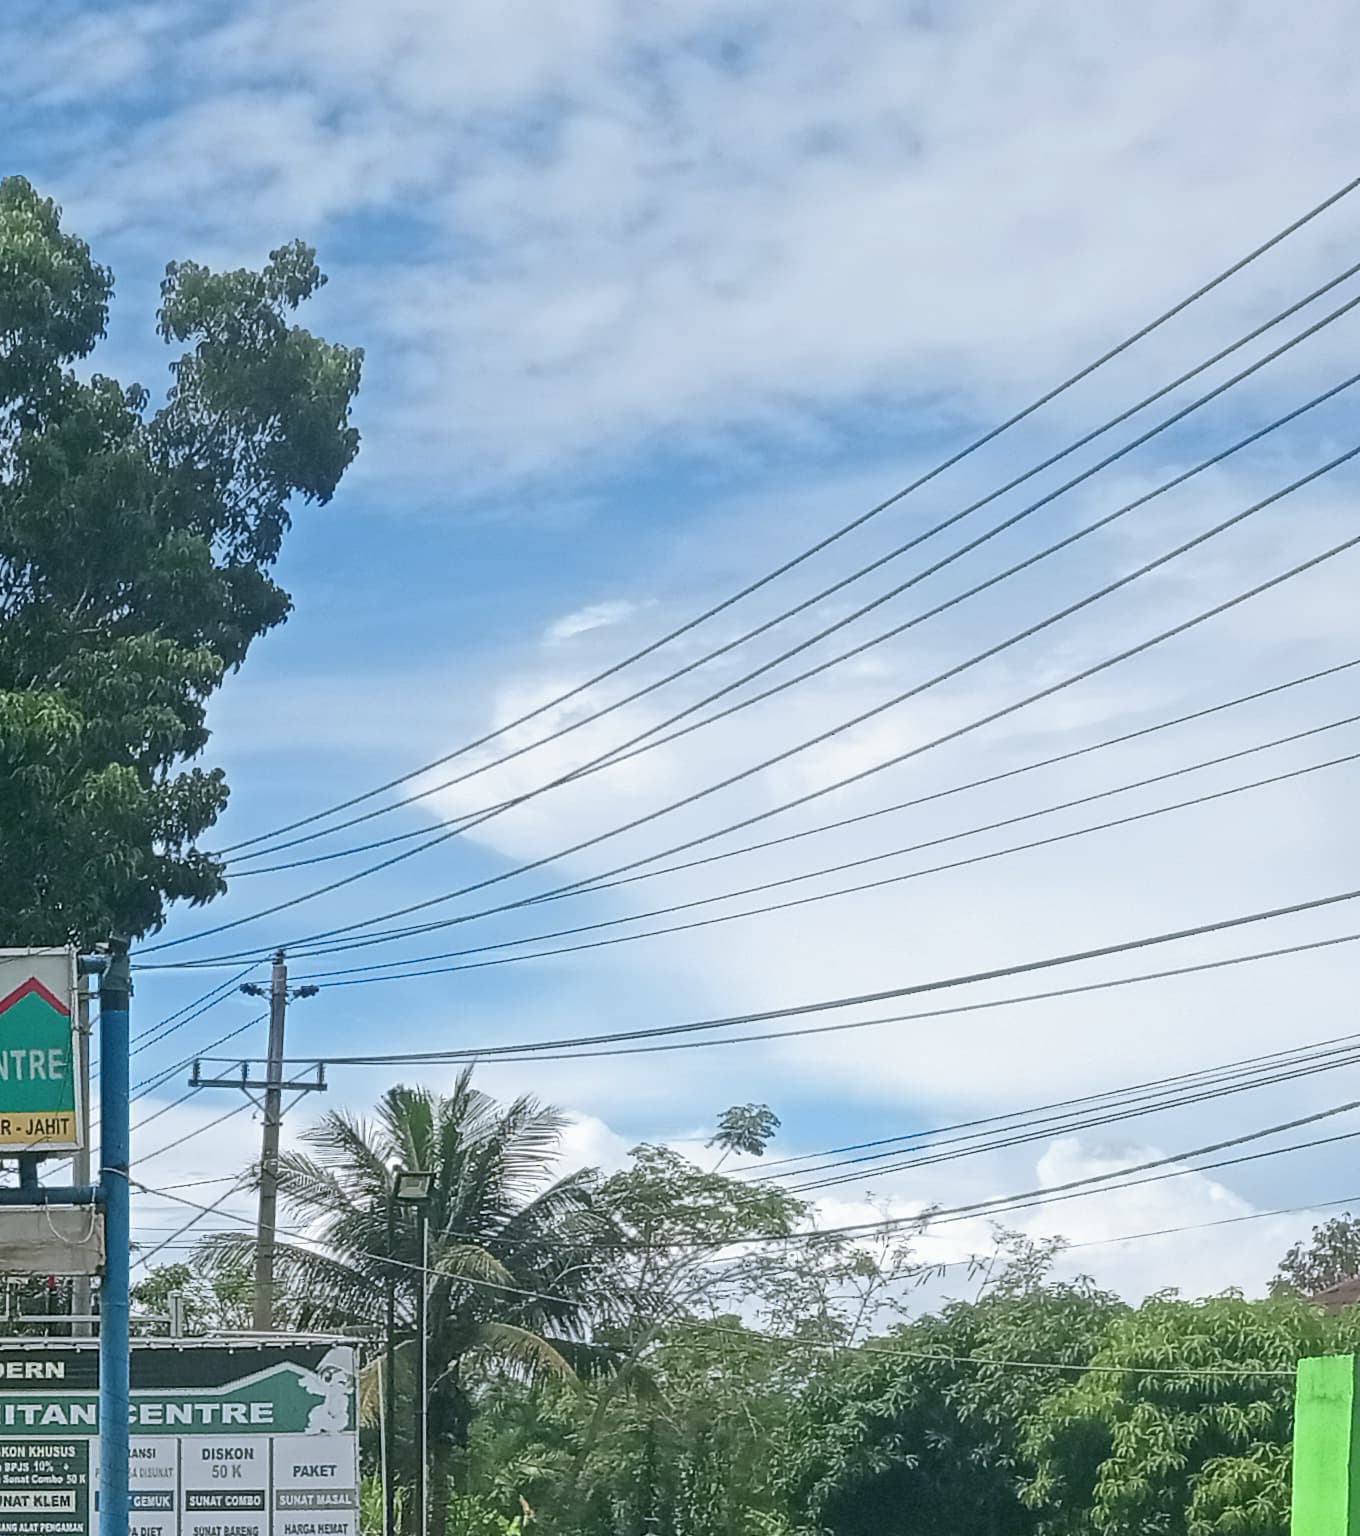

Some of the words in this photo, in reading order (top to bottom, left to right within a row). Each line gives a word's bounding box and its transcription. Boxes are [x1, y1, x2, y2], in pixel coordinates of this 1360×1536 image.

[26, 1118, 70, 1136] JAHIT
[29, 1446, 76, 1457] KHUSUS
[202, 1448, 254, 1460] DISKON
[4, 1462, 29, 1472] BPJS
[33, 1461, 54, 1472] 10%
[212, 1465, 228, 1478] 50
[232, 1465, 243, 1478] K
[293, 1464, 337, 1477] PAKET
[66, 1474, 77, 1484] 50
[33, 1495, 71, 1507] KLEM
[133, 1496, 170, 1507] GEMUK
[189, 1496, 223, 1507] SUNAT
[225, 1496, 261, 1507] COMBO
[279, 1495, 316, 1505] SUNAT
[317, 1495, 353, 1505] MASAL
[140, 1527, 163, 1536] DIET
[192, 1526, 223, 1536] SUNAT
[224, 1526, 259, 1536] BARENG
[284, 1524, 316, 1535] HARGA
